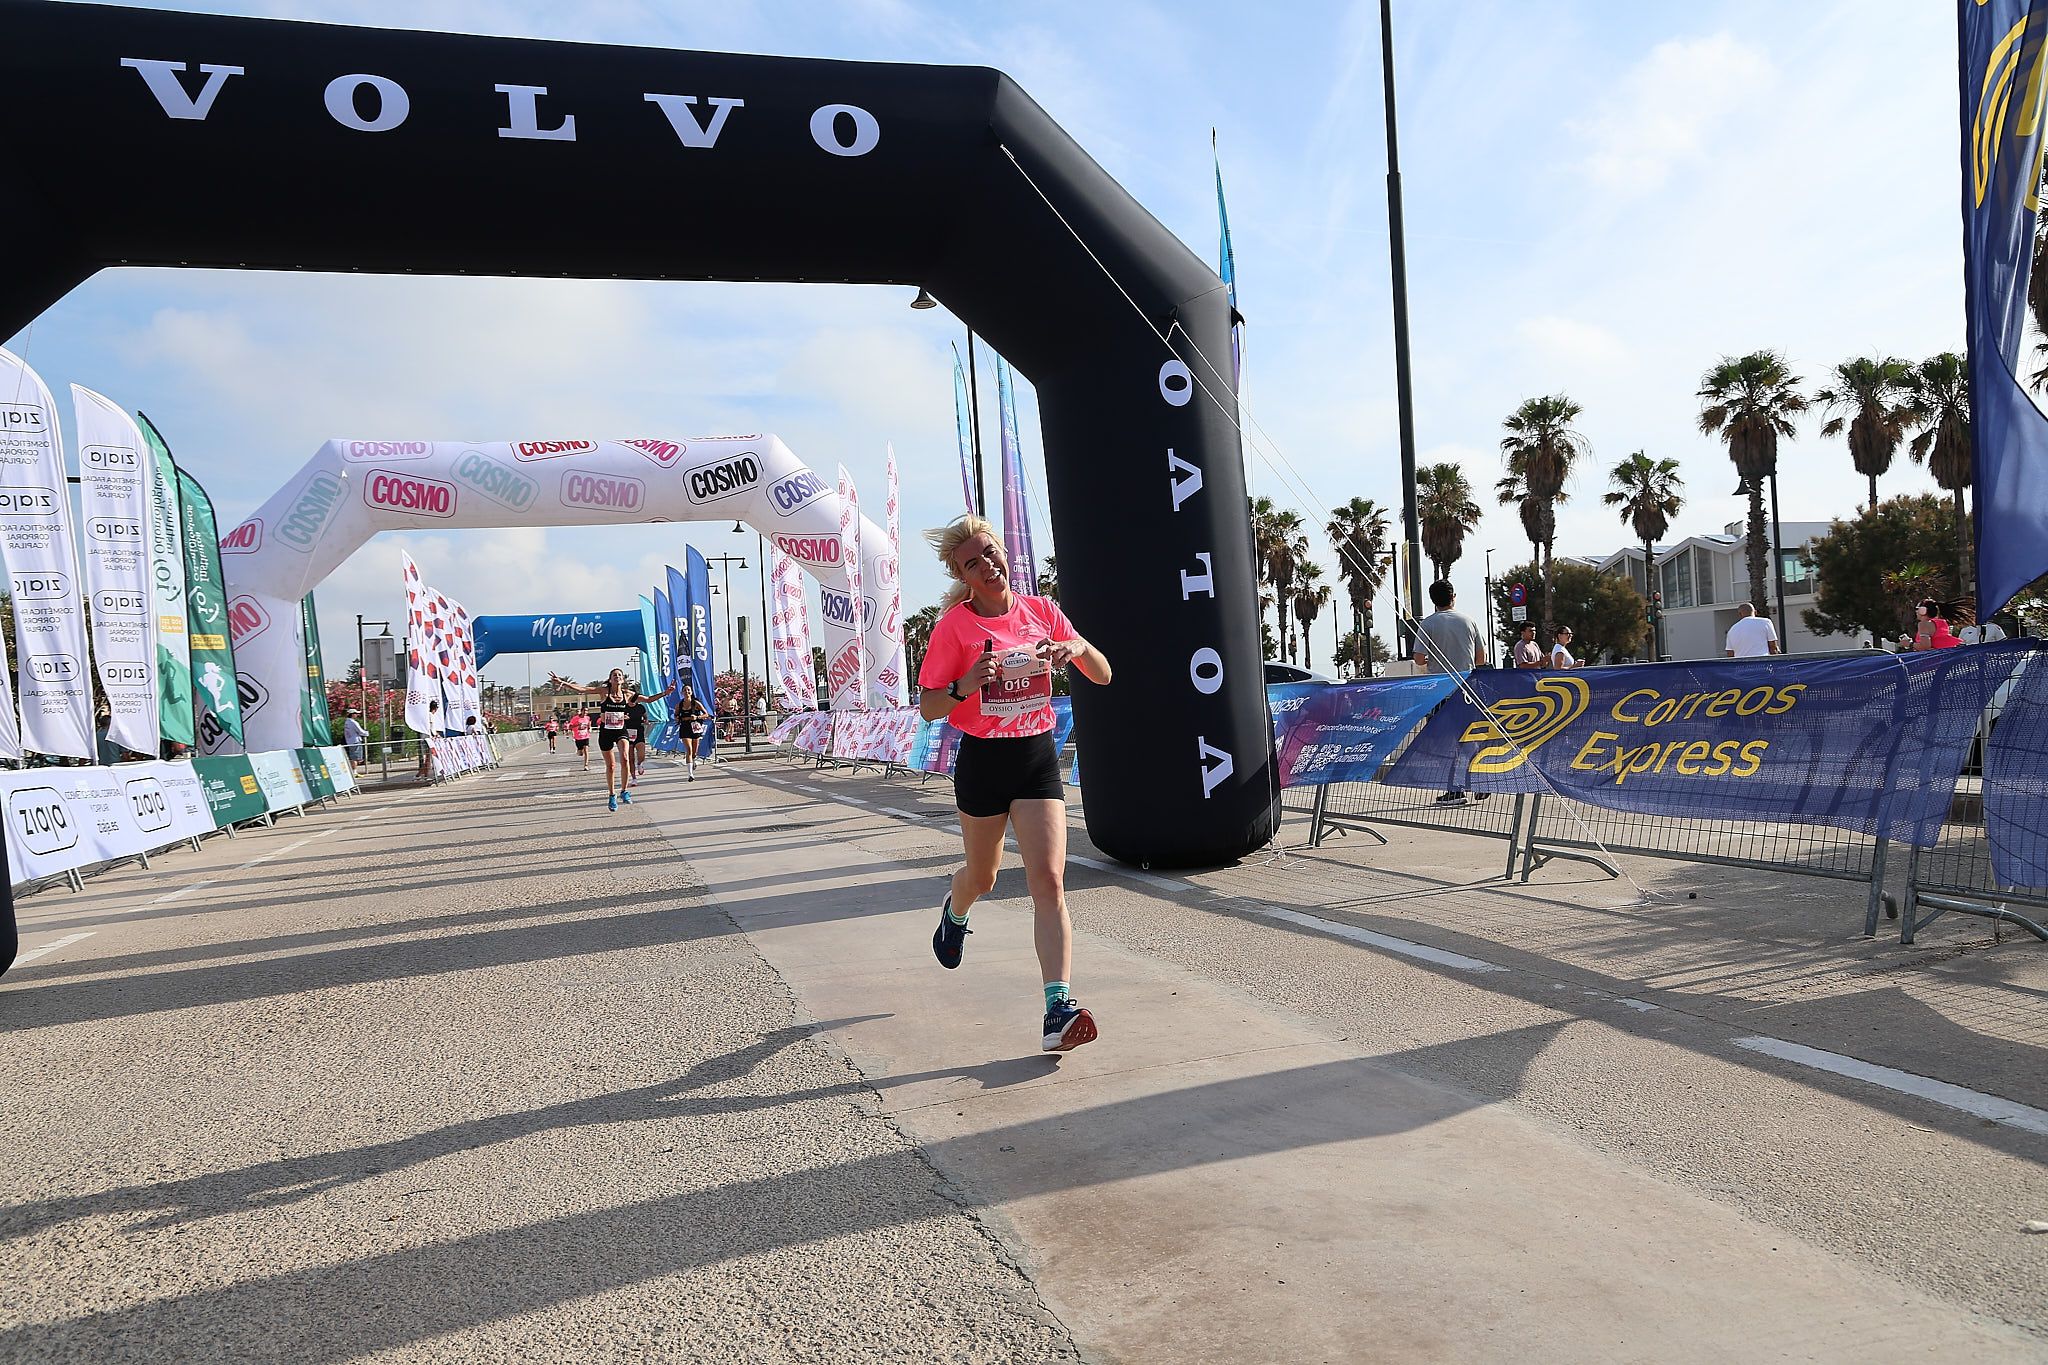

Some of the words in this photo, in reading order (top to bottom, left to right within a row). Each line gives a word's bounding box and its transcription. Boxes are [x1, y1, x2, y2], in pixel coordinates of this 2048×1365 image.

[119, 57, 881, 157] VOLVO
[350, 441, 426, 458] COSMO
[372, 475, 450, 513] COSMO
[459, 454, 533, 507] COSMO
[568, 475, 639, 509] COSMO
[691, 456, 758, 500] COSMO
[773, 471, 828, 510] COSMO
[281, 473, 341, 545] COSMO
[777, 537, 839, 563] COSMO
[1158, 360, 1234, 799] VOLVO
[532, 616, 603, 647] Marlene
[1004, 677, 1030, 691] 016
[1610, 683, 1807, 727] Correos
[1570, 730, 1769, 785] Express
[19, 804, 68, 842] ziaja
[131, 790, 166, 822] ziaja
